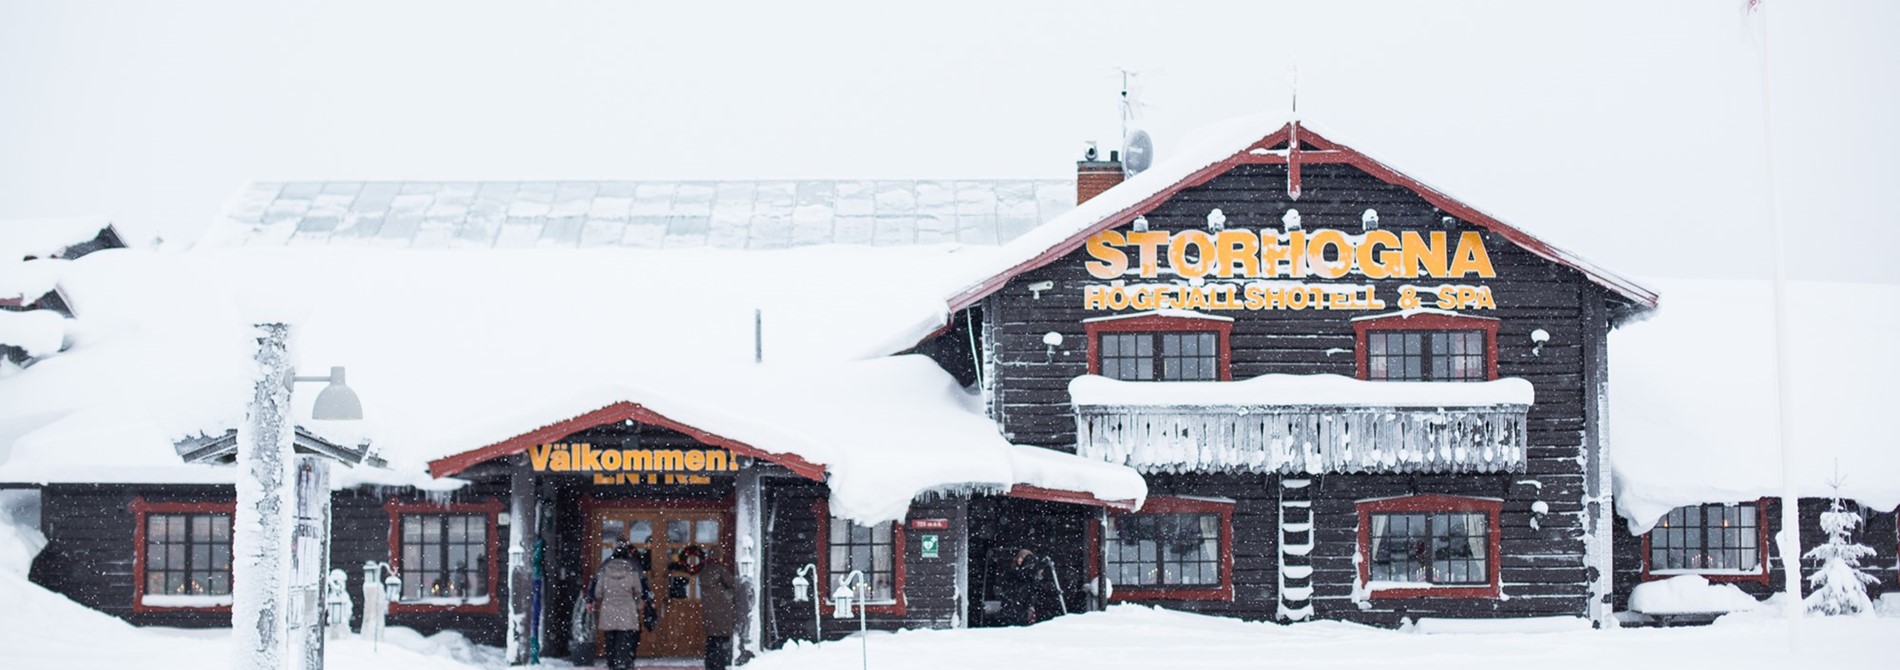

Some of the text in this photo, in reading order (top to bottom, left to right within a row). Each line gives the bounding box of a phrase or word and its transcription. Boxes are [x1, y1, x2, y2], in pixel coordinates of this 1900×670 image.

[1084, 229, 1497, 280] STORHOGNA
[1398, 286, 1422, 310] &
[1437, 286, 1496, 310] SPA
[529, 443, 739, 472] Välkommen!
